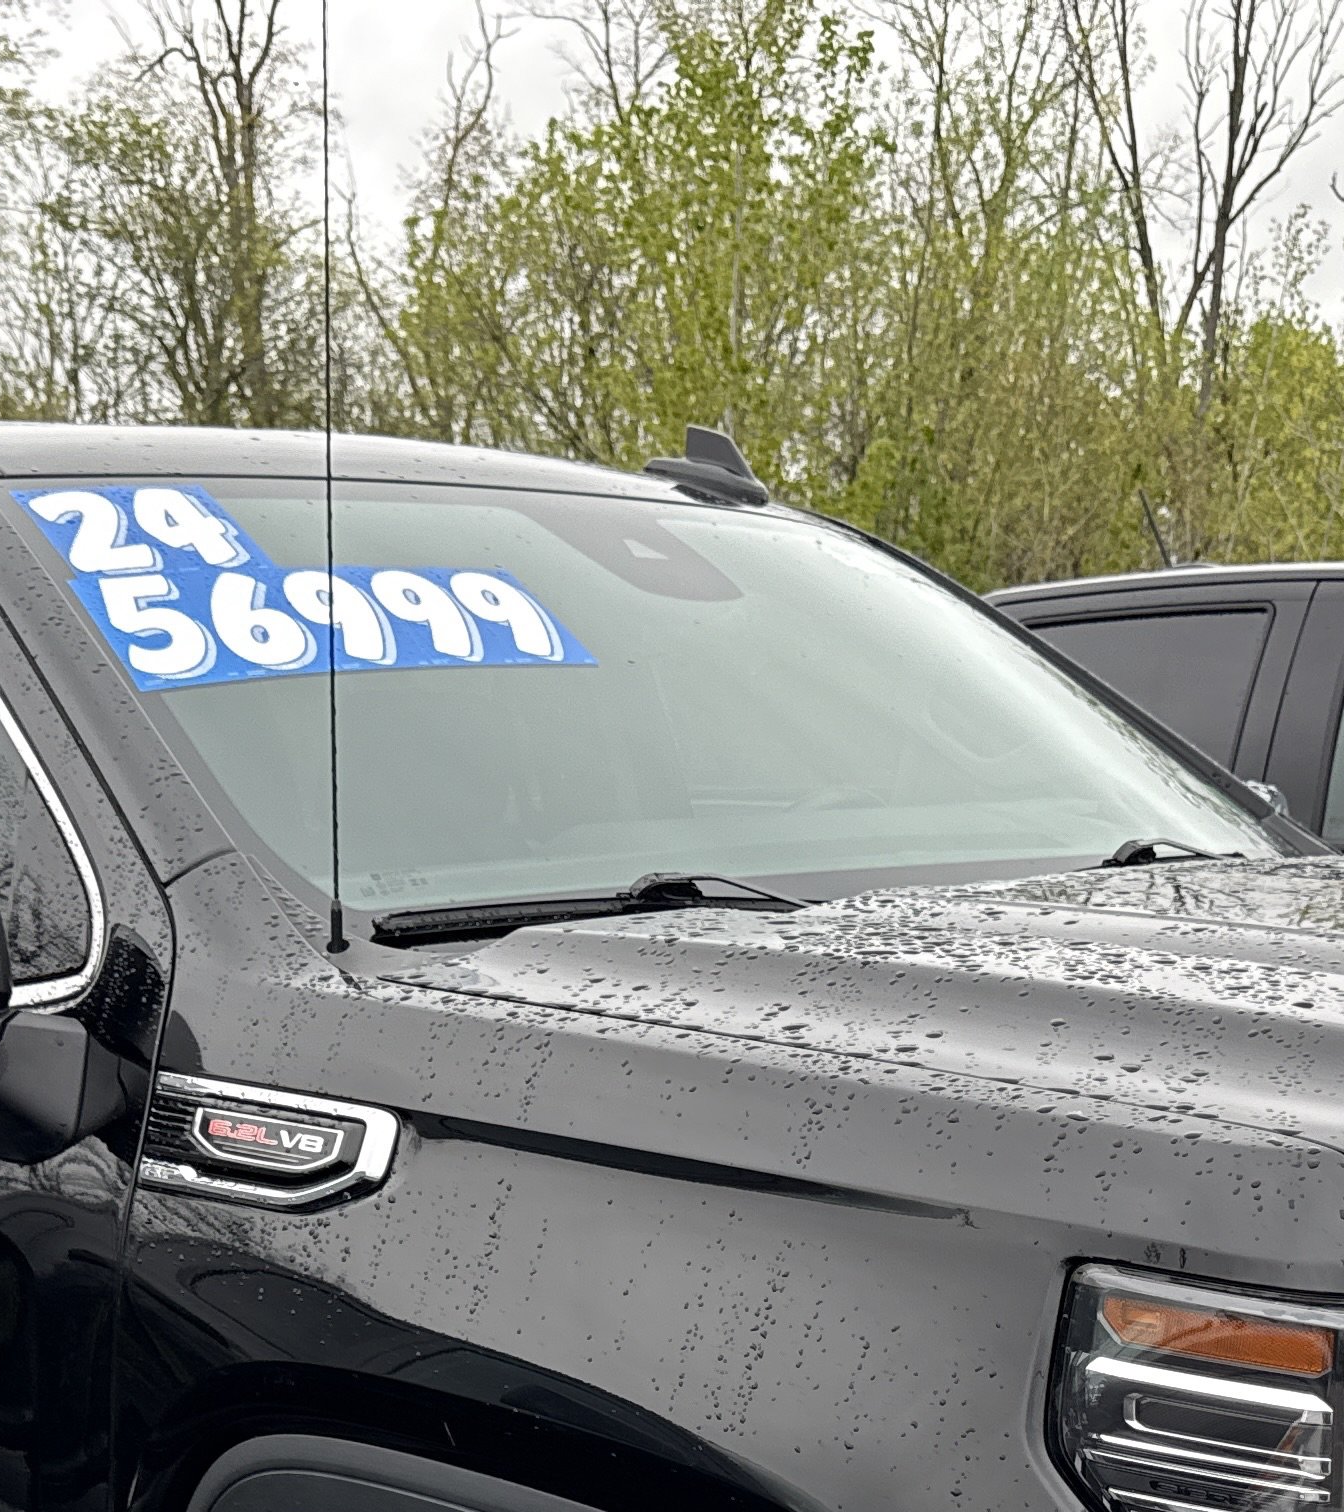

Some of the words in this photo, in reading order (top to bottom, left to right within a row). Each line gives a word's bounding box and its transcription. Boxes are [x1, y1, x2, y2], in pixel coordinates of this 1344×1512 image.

[29, 487, 251, 574] 24
[99, 569, 564, 679] 56999
[207, 1119, 278, 1146] 6.2L
[279, 1129, 324, 1153] V8
